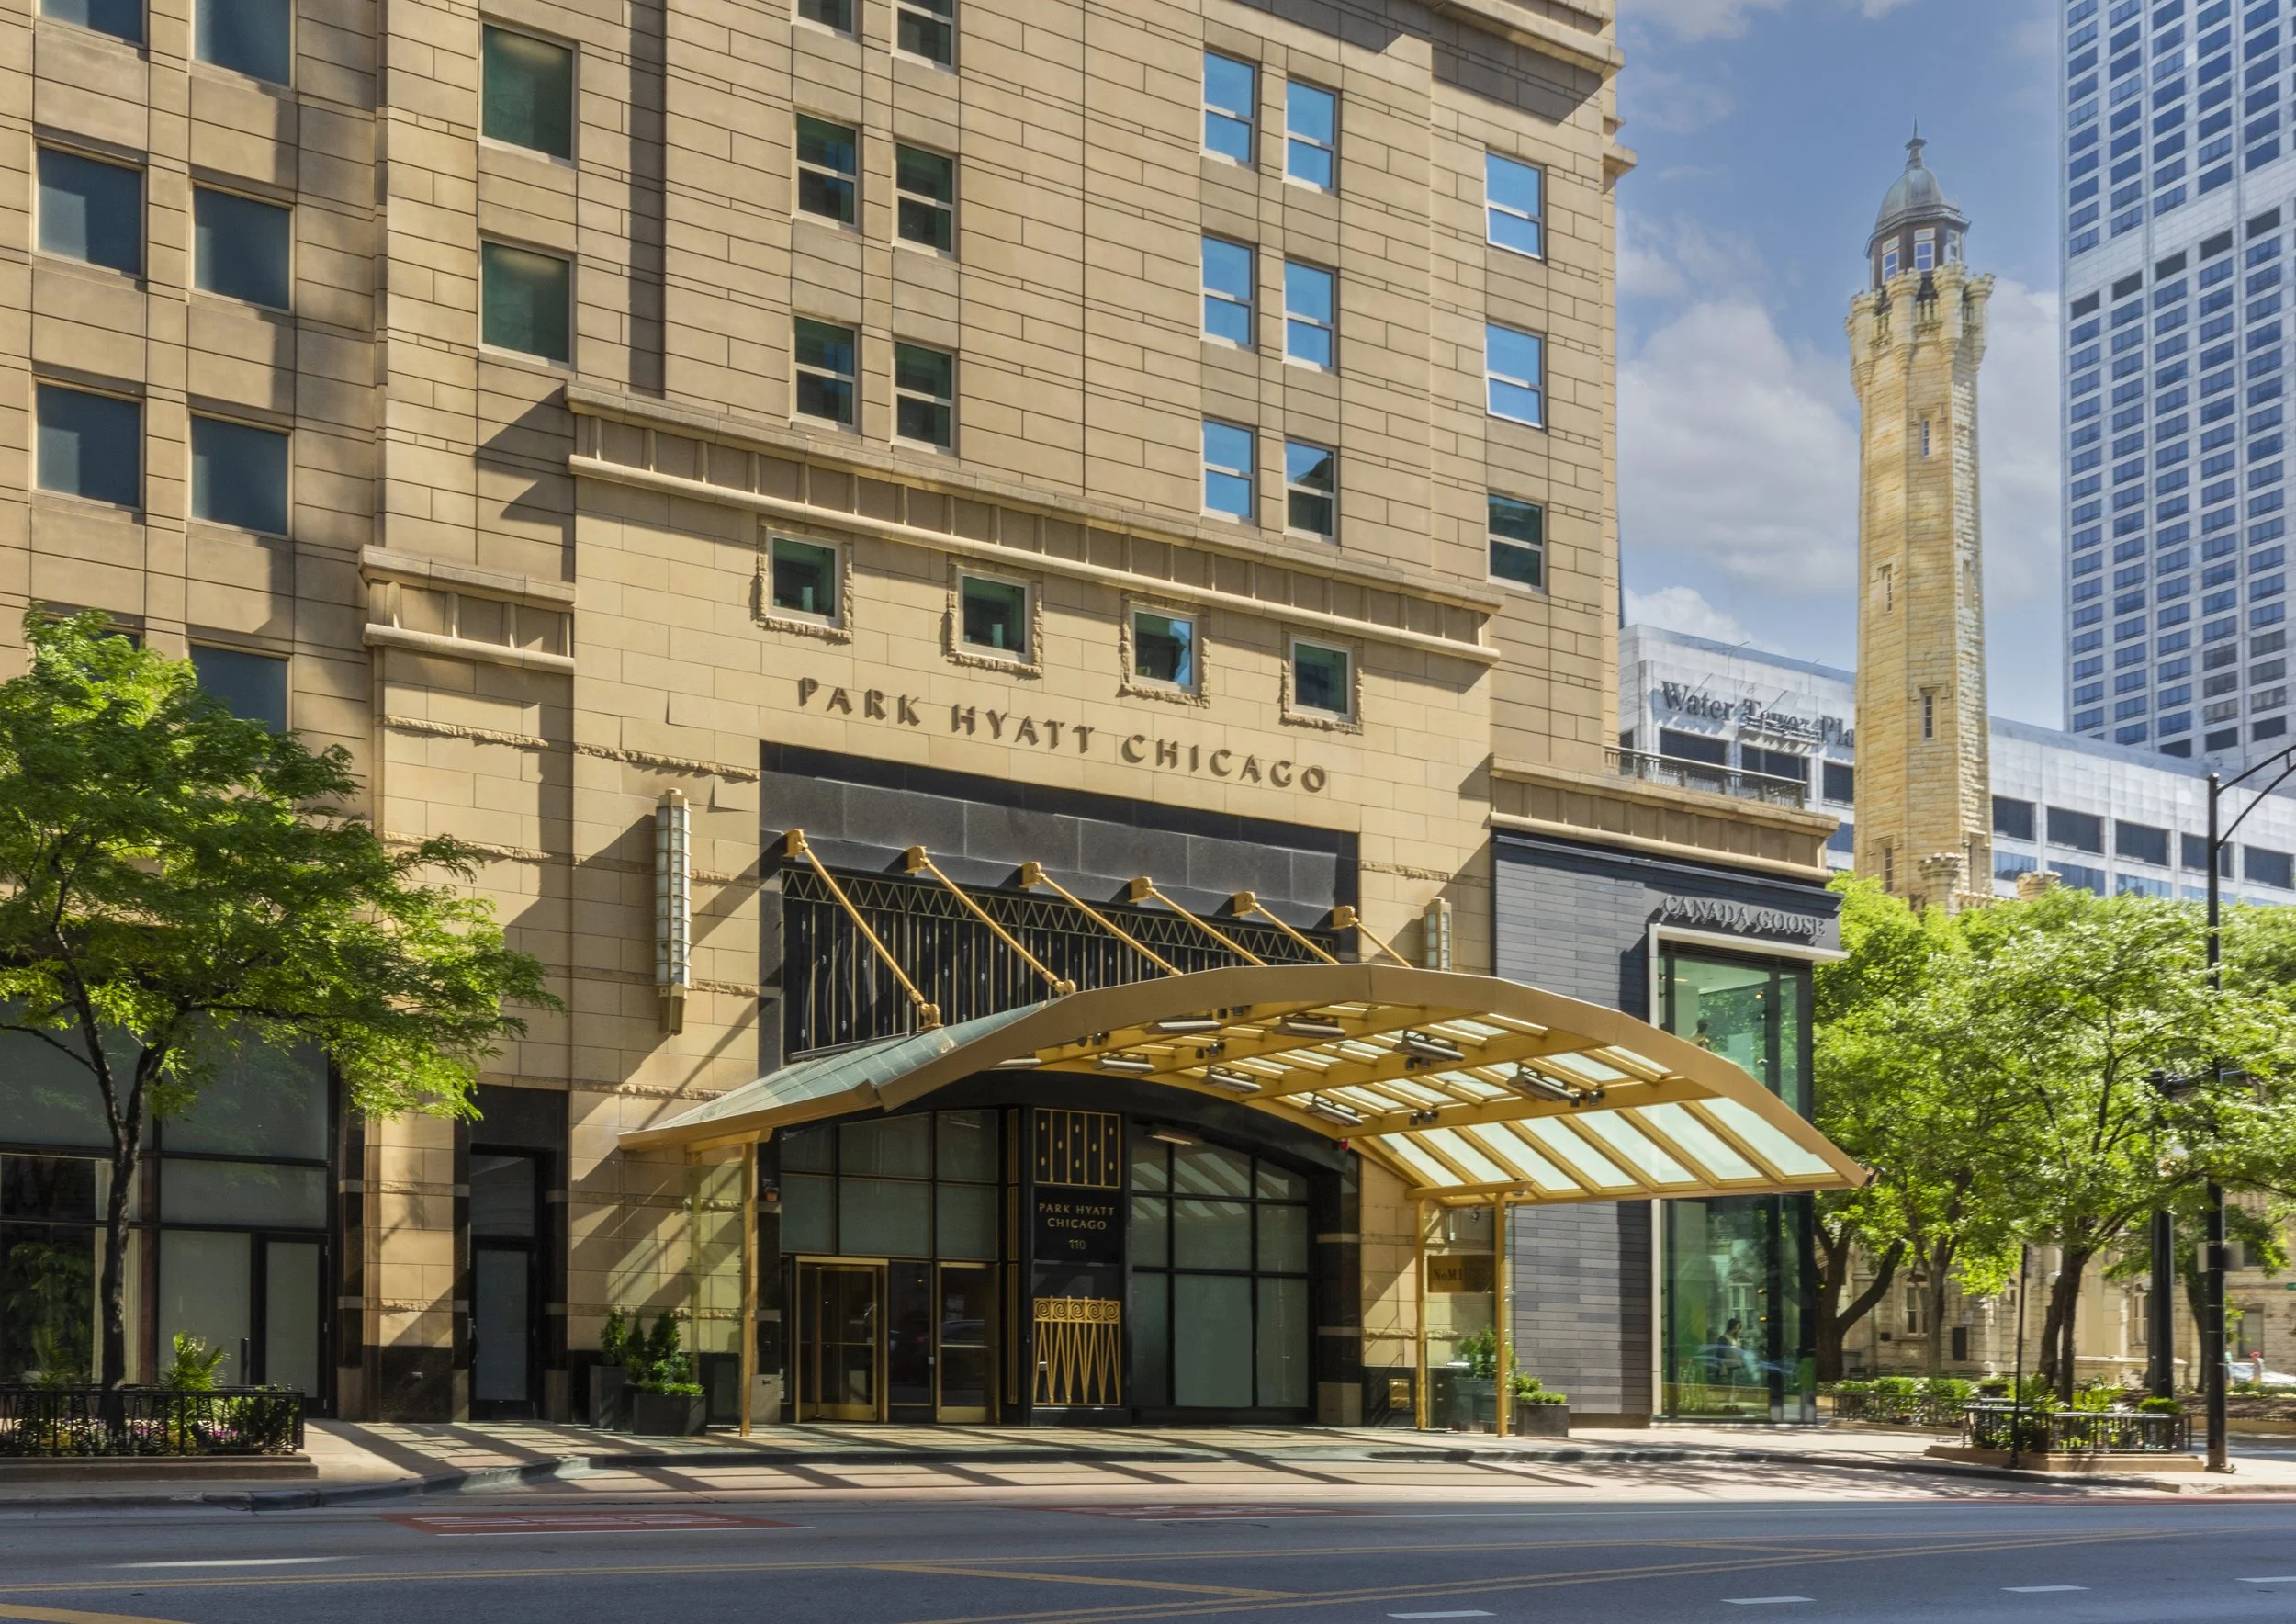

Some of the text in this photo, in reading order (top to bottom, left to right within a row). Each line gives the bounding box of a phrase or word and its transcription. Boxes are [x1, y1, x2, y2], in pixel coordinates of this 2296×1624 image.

[1661, 681, 1735, 721] Water
[798, 677, 1327, 792] PARK HYATT CHICAGO
[1664, 896, 1827, 937] CANADA GOOSE
[1039, 1202, 1115, 1216] PARK HYATT
[1047, 1217, 1107, 1230] CHICAGO
[1068, 1239, 1086, 1250] 110
